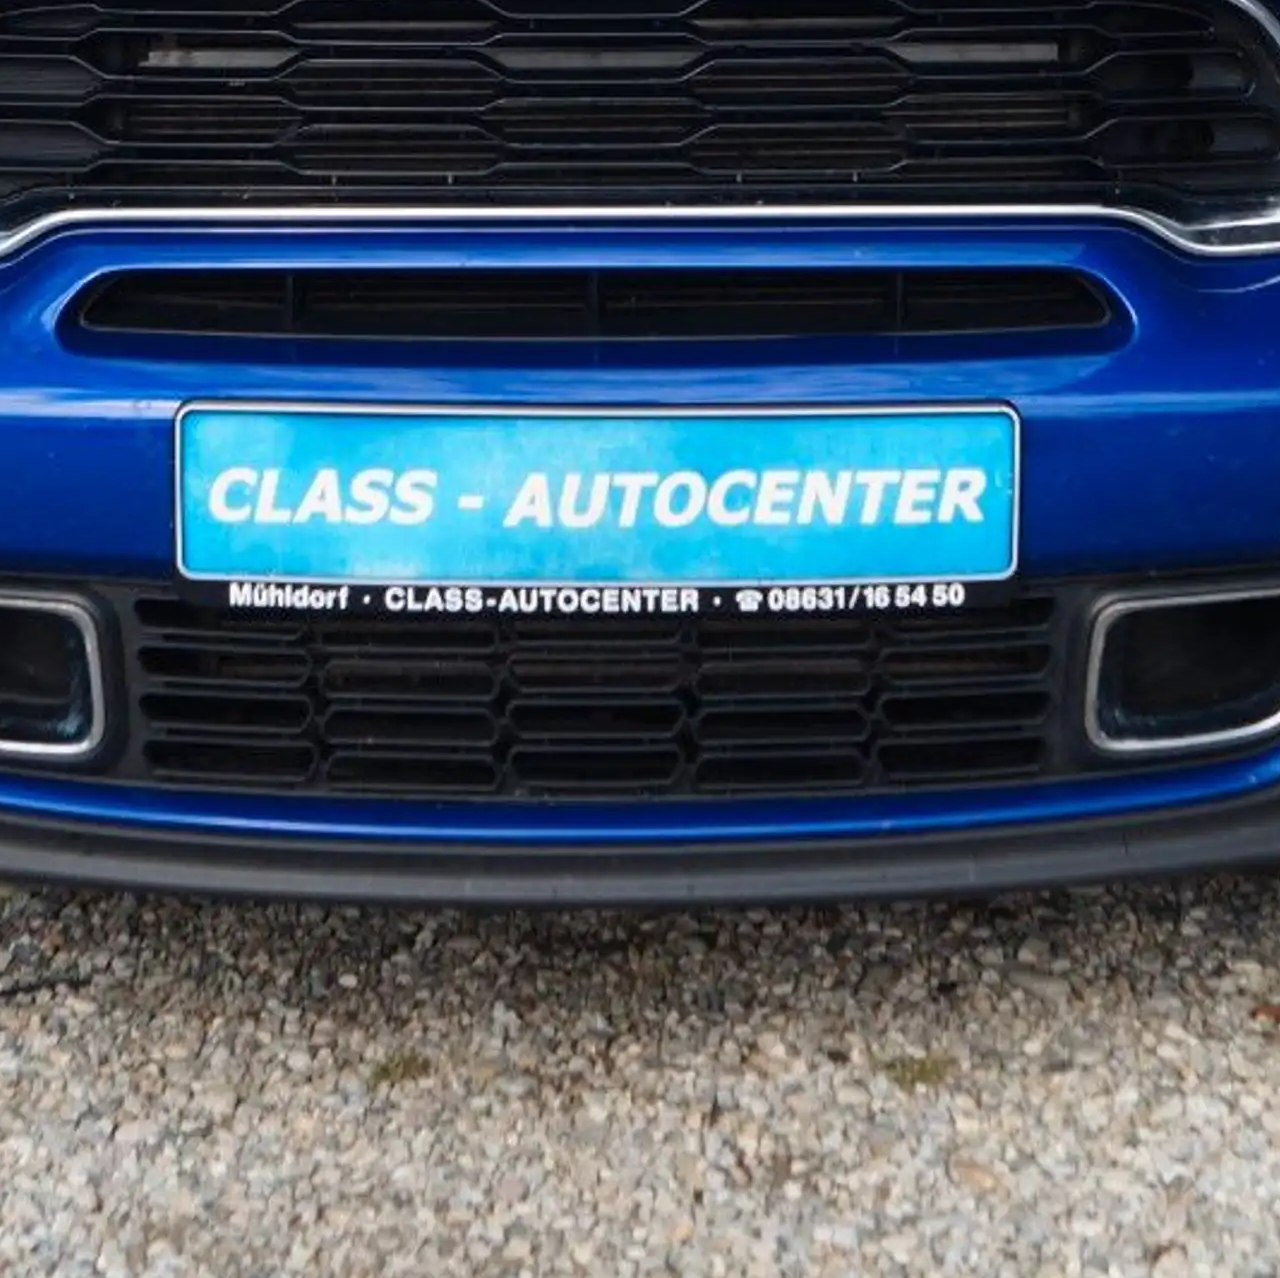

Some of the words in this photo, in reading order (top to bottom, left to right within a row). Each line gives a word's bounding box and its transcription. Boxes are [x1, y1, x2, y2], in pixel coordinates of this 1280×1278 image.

[208, 467, 437, 525] CLASS
[503, 470, 986, 528] AUTOCENTER
[228, 582, 349, 610] Mühldorf
[384, 588, 700, 614] CLASS-AUTOCENTER
